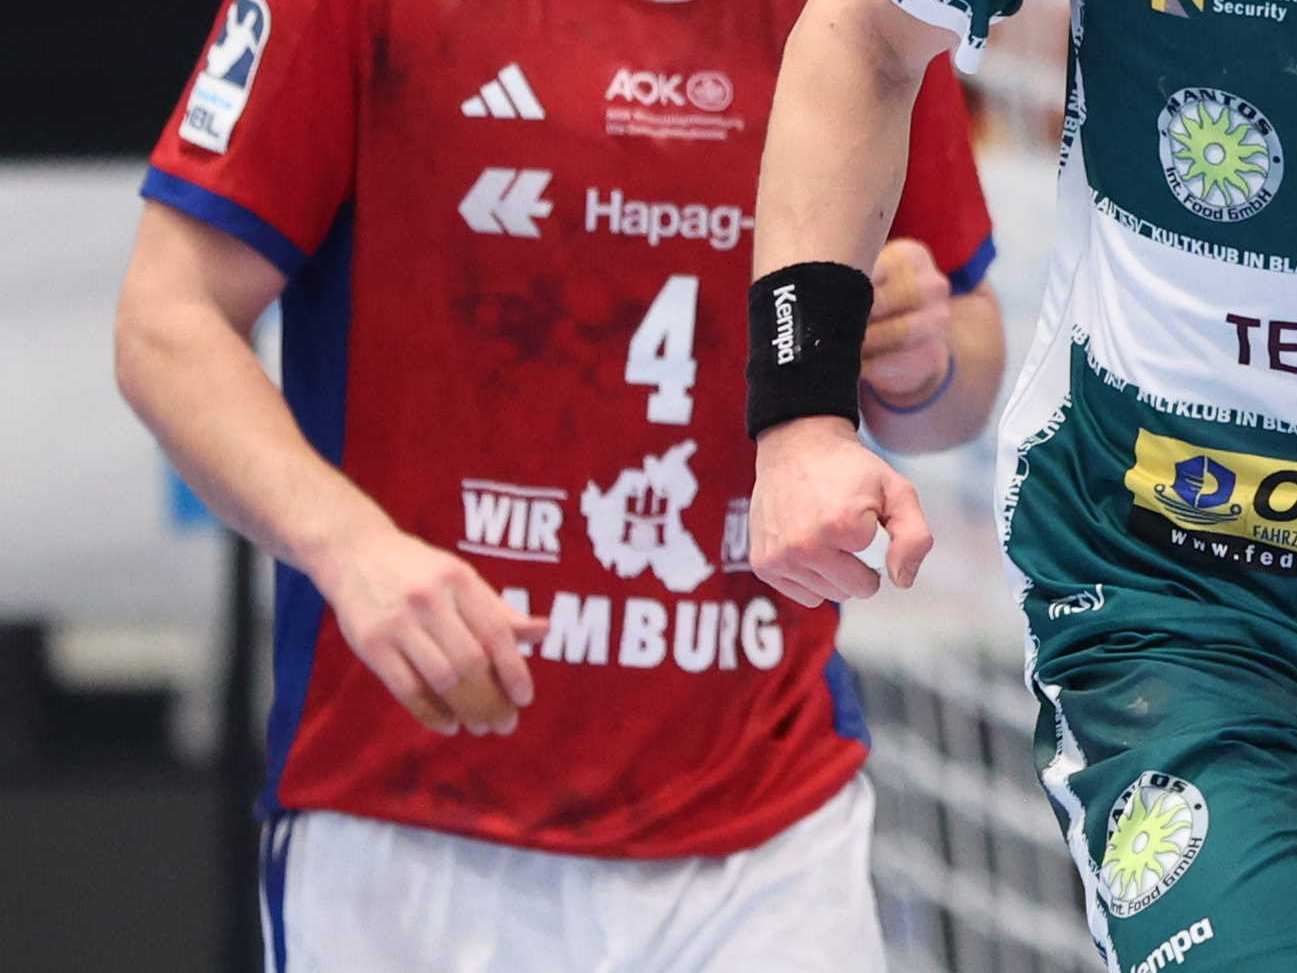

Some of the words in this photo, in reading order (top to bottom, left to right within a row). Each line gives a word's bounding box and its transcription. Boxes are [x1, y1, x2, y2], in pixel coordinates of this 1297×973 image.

[605, 68, 686, 107] AOK
[1166, 89, 1273, 136] MANTOS
[585, 187, 755, 251] Hapag-
[1166, 167, 1181, 196] Int.
[1183, 194, 1223, 220] Food
[1228, 188, 1272, 220] GmbH
[1151, 227, 1239, 264] KULTKLUB
[1243, 251, 1264, 270] IN
[625, 275, 699, 425] 4
[772, 284, 797, 365] Kempa
[1236, 409, 1258, 428] IN
[461, 490, 563, 556] WIR
[1127, 885, 1161, 915] Food
[1162, 837, 1202, 887] GmbH
